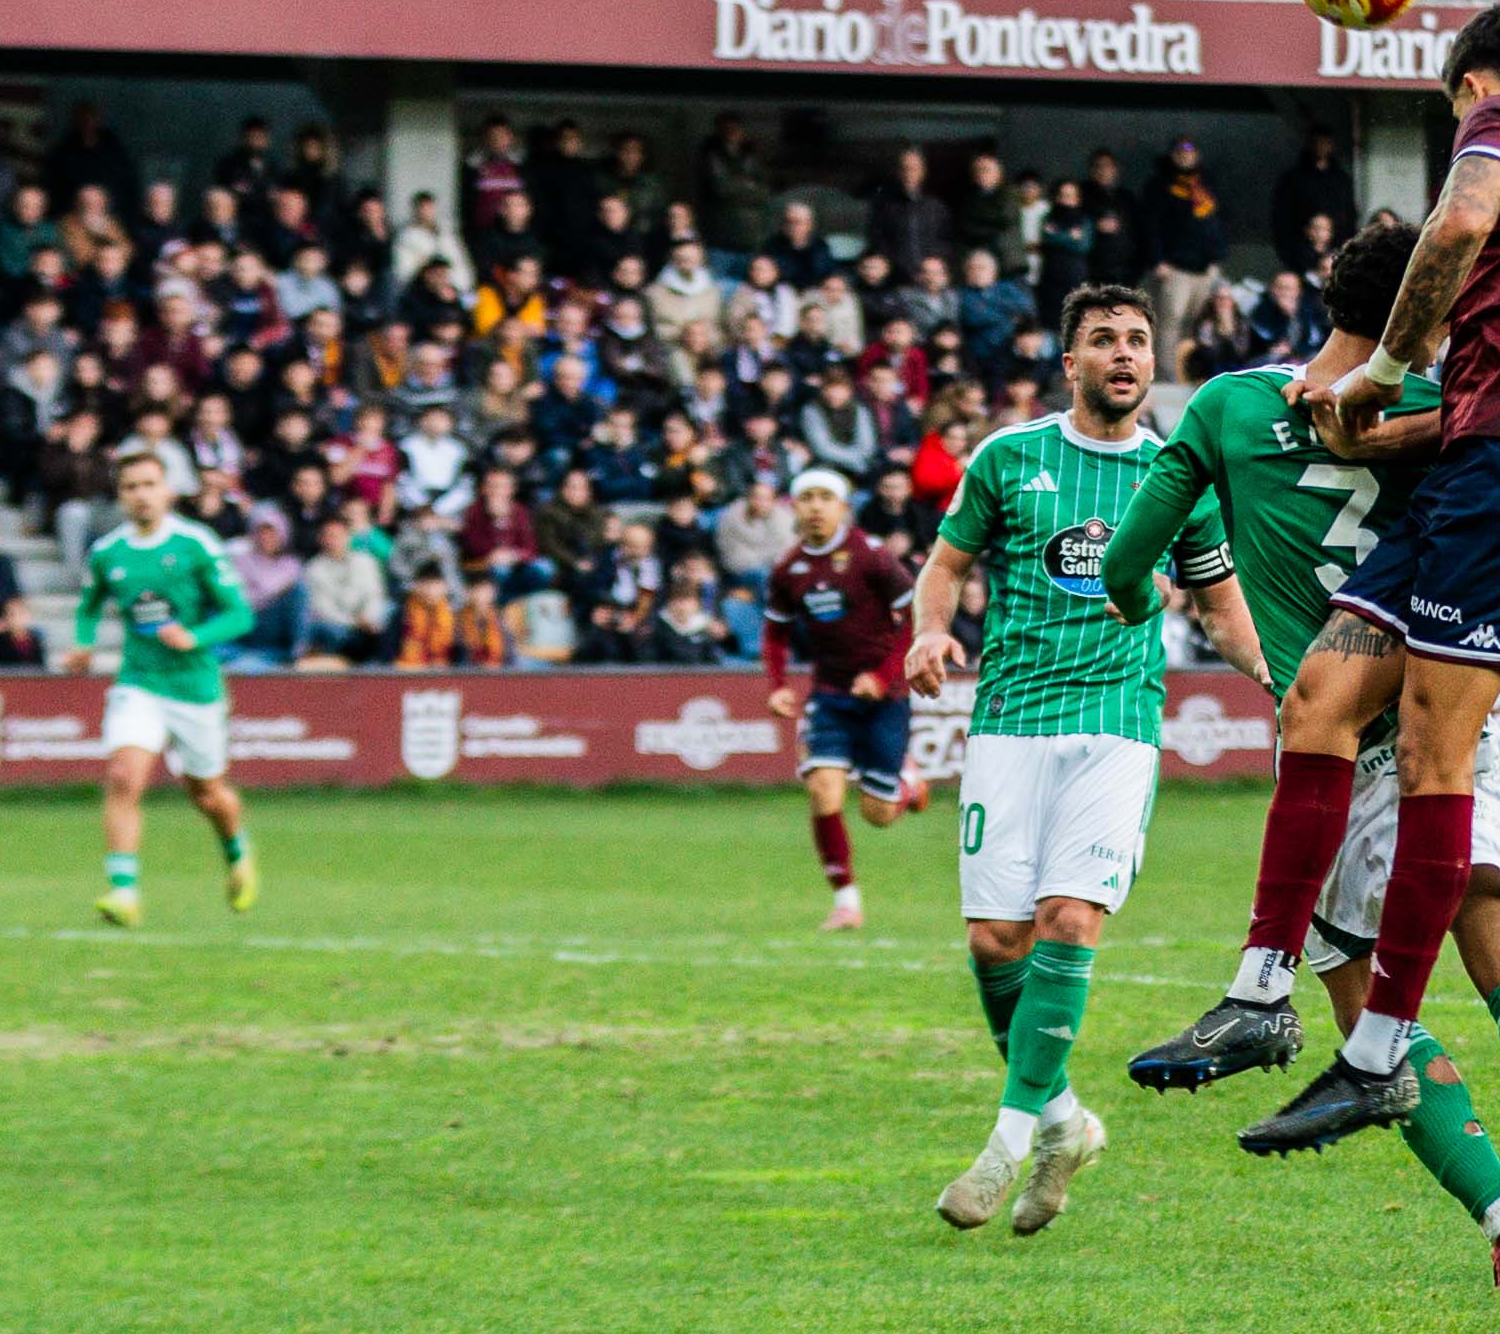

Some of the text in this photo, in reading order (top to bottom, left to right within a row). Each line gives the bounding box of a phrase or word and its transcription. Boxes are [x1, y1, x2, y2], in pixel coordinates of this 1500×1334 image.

[1296, 463, 1381, 595] 3
[1058, 537, 1107, 557] Estre
[1060, 557, 1100, 576] Gali
[1410, 595, 1463, 624] BANCA
[963, 802, 986, 856] 0
